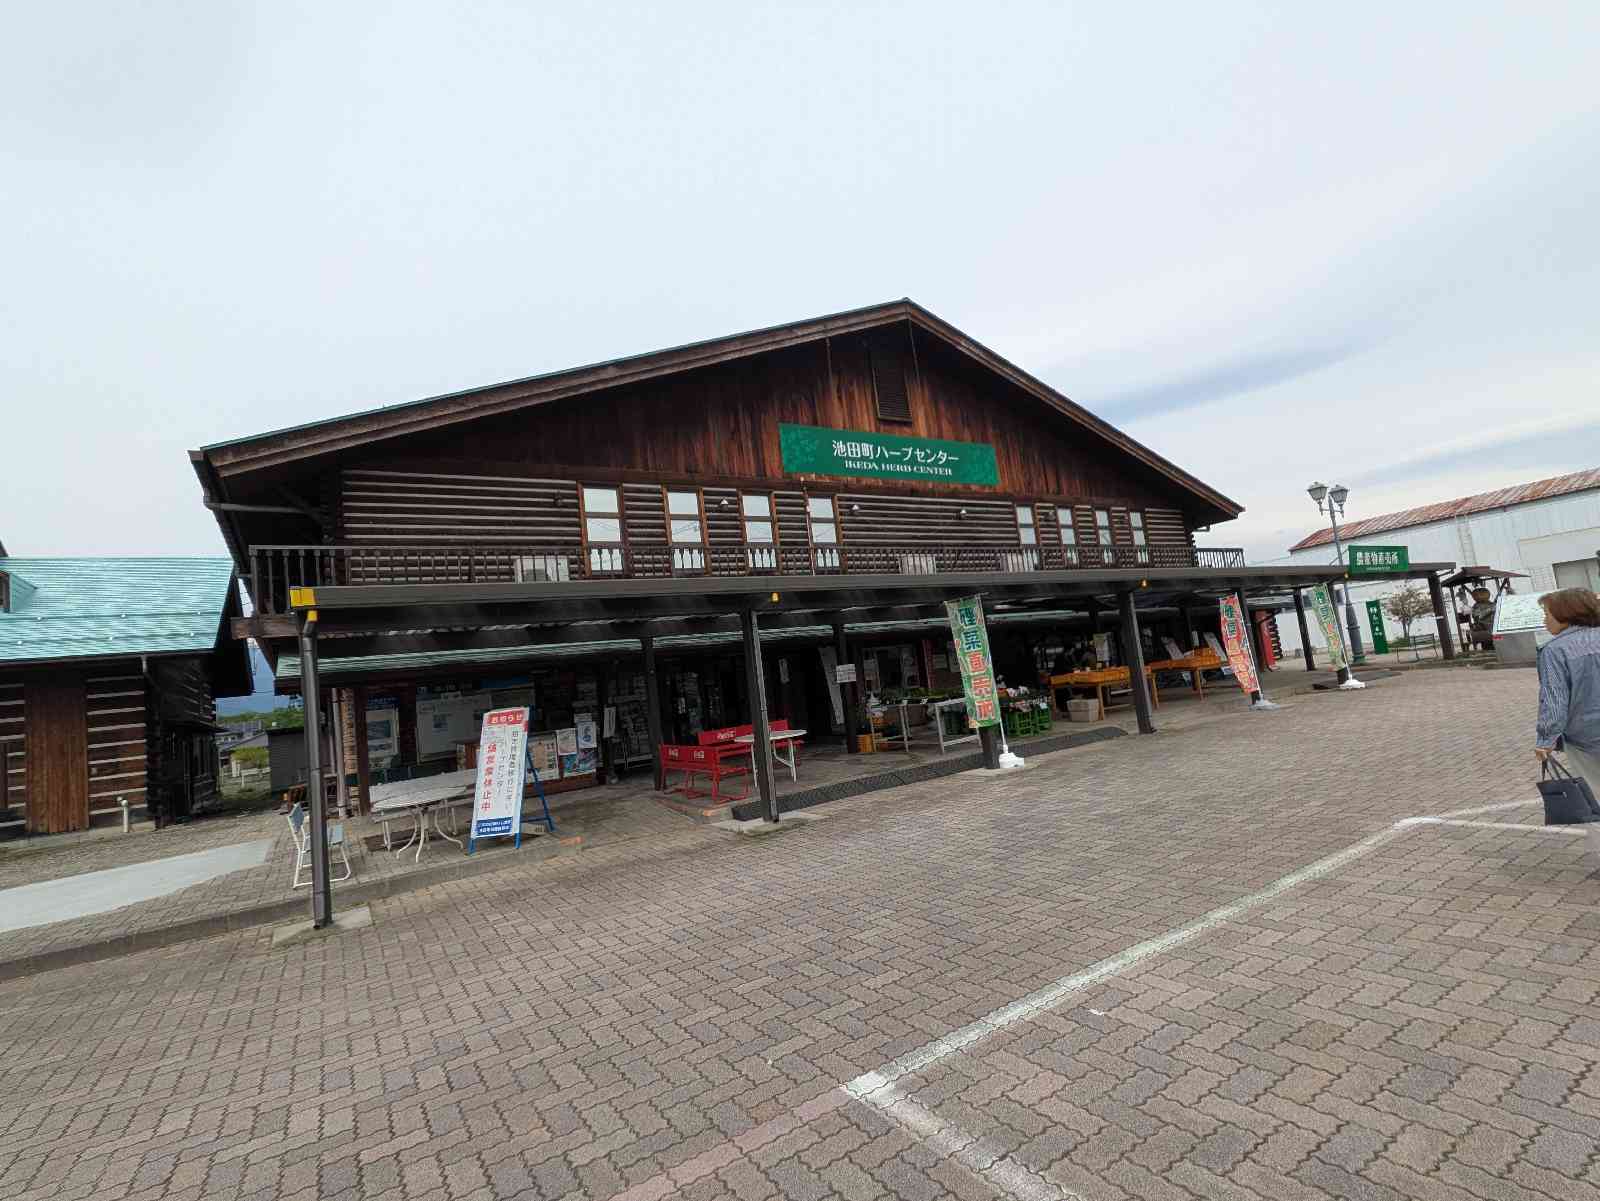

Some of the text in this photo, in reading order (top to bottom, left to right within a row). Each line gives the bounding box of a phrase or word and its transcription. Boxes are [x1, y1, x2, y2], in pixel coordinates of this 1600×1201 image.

[832, 440, 959, 464] 池田町ハーブセンター
[845, 460, 952, 475] IKEDA HERB CENTER
